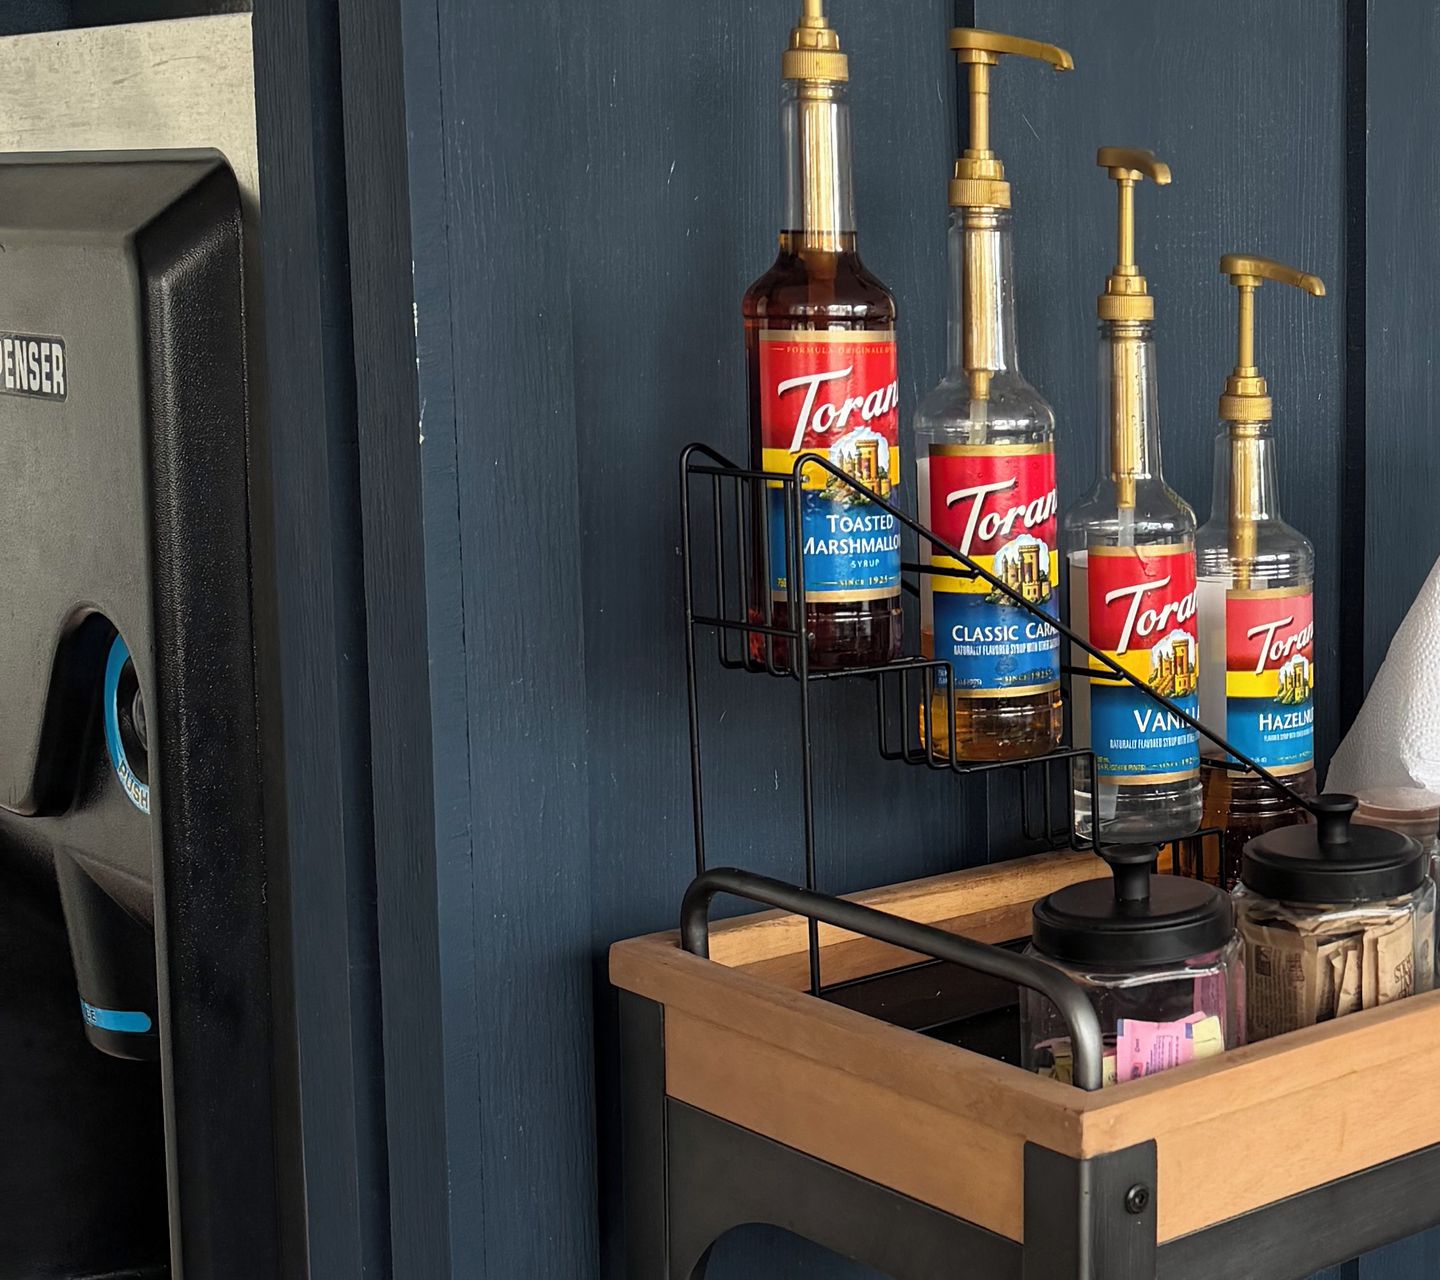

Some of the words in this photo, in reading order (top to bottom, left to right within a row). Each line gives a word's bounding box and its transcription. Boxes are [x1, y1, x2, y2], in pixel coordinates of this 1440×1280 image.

[777, 365, 899, 454] Toran
[826, 514, 894, 534] TOASTED
[946, 477, 1058, 558] Toran
[804, 534, 900, 556] MARSHMALLO
[850, 558, 880, 569] SYRUP
[869, 575, 888, 585] 1925
[952, 625, 1019, 642] CLASSIC
